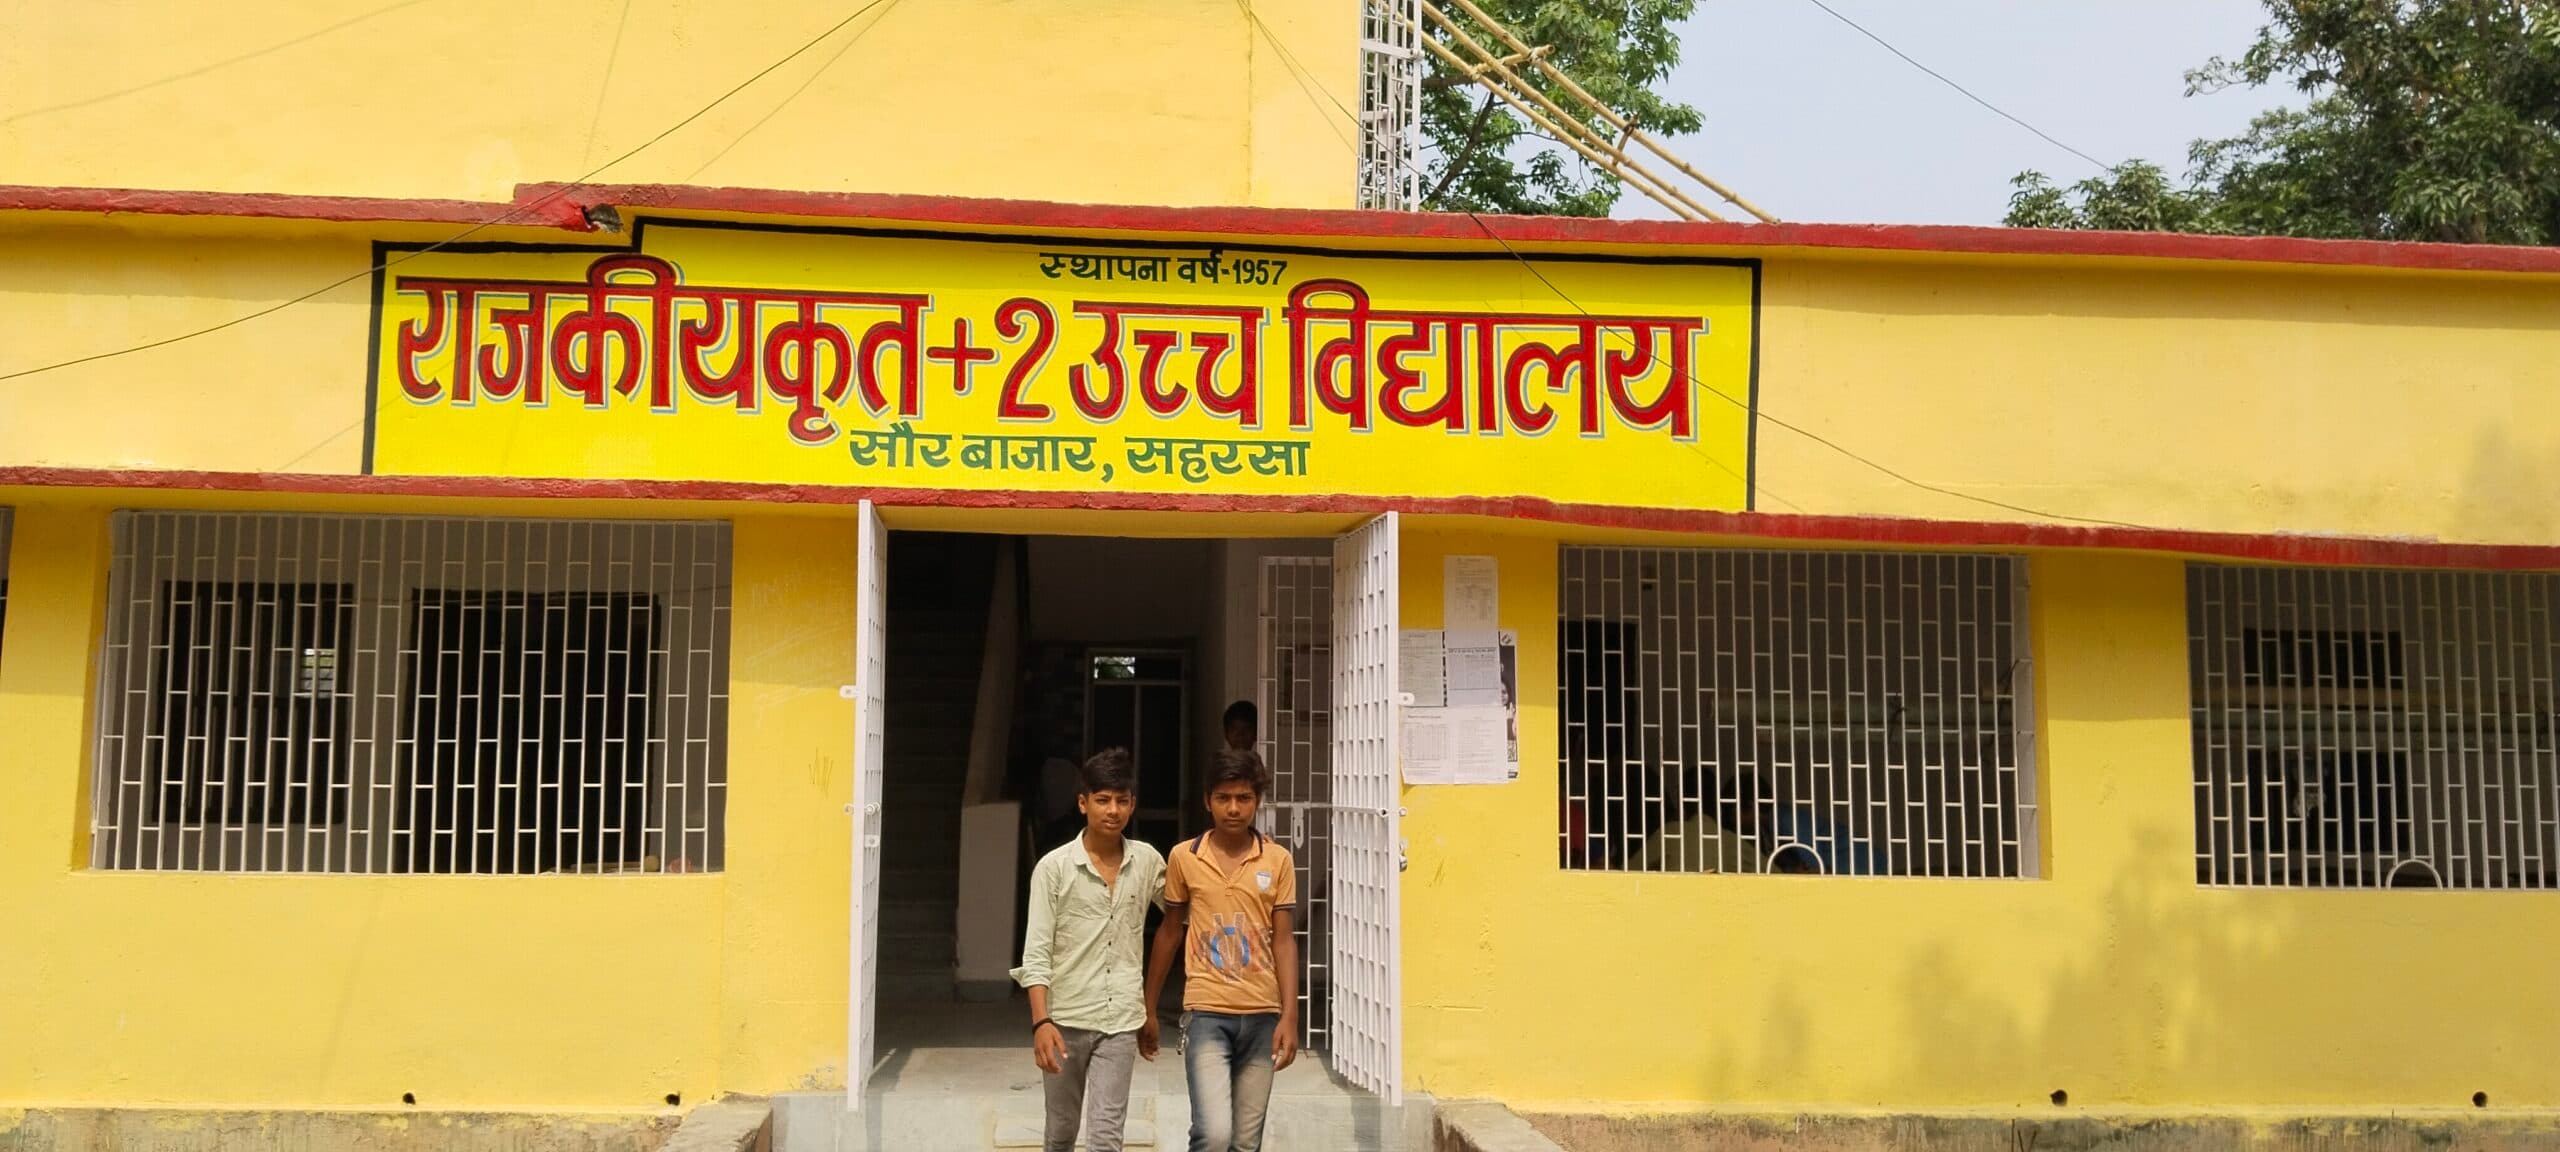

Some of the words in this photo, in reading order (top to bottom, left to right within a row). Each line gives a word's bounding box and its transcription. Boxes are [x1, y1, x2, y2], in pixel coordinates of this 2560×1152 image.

[1039, 252, 1171, 282] स्थापना
[1069, 299, 1265, 430] उच्च
[1281, 278, 1704, 440] विद्यालय
[849, 422, 952, 467] सौर
[961, 434, 1113, 483] बाजार,
[1124, 436, 1311, 483] सहरसा
